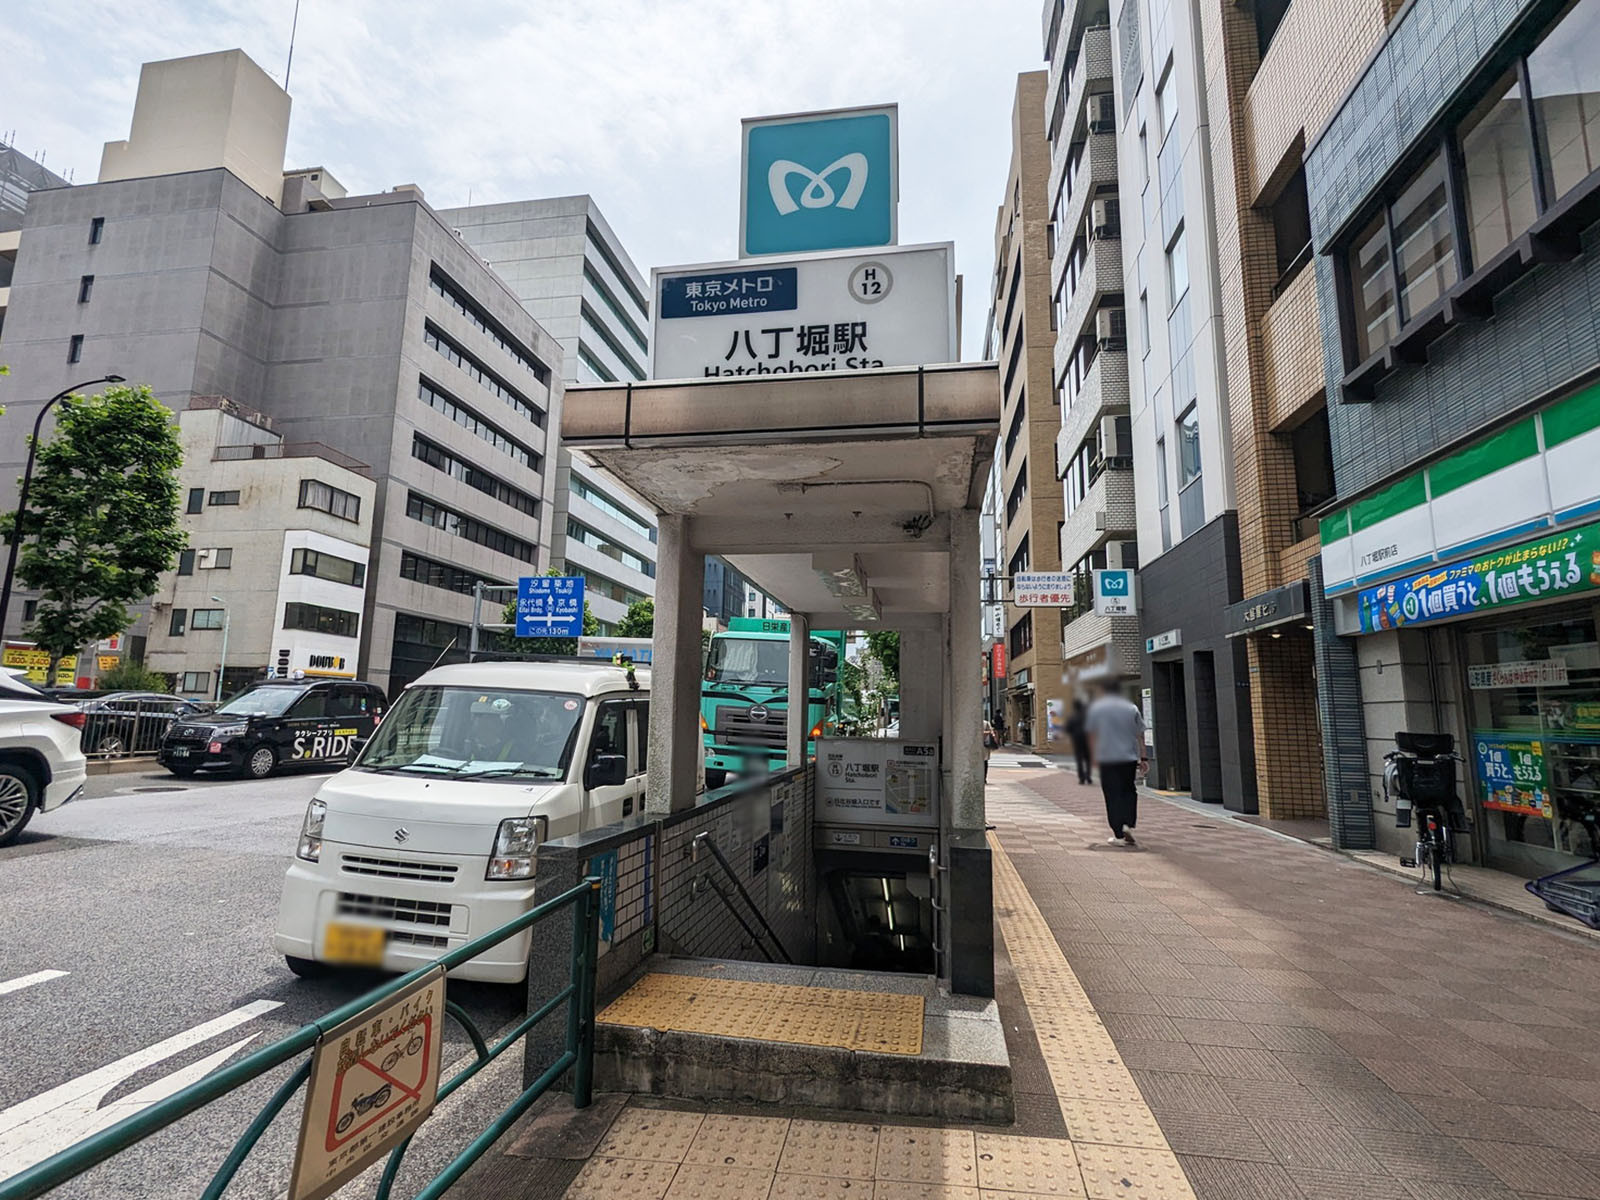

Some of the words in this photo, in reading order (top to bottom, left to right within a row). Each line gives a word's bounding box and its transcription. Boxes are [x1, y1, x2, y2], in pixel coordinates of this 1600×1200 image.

[864, 268, 876, 281] H
[685, 276, 773, 299] 東京メトロ
[861, 282, 882, 295] 12
[690, 300, 727, 313] Tokyo
[730, 297, 768, 309] Metro
[724, 321, 868, 361] 八丁堀駅
[1019, 593, 1071, 604] 歩行者優先
[762, 621, 791, 632] 日栄産
[845, 763, 880, 773] 八丁堀駅
